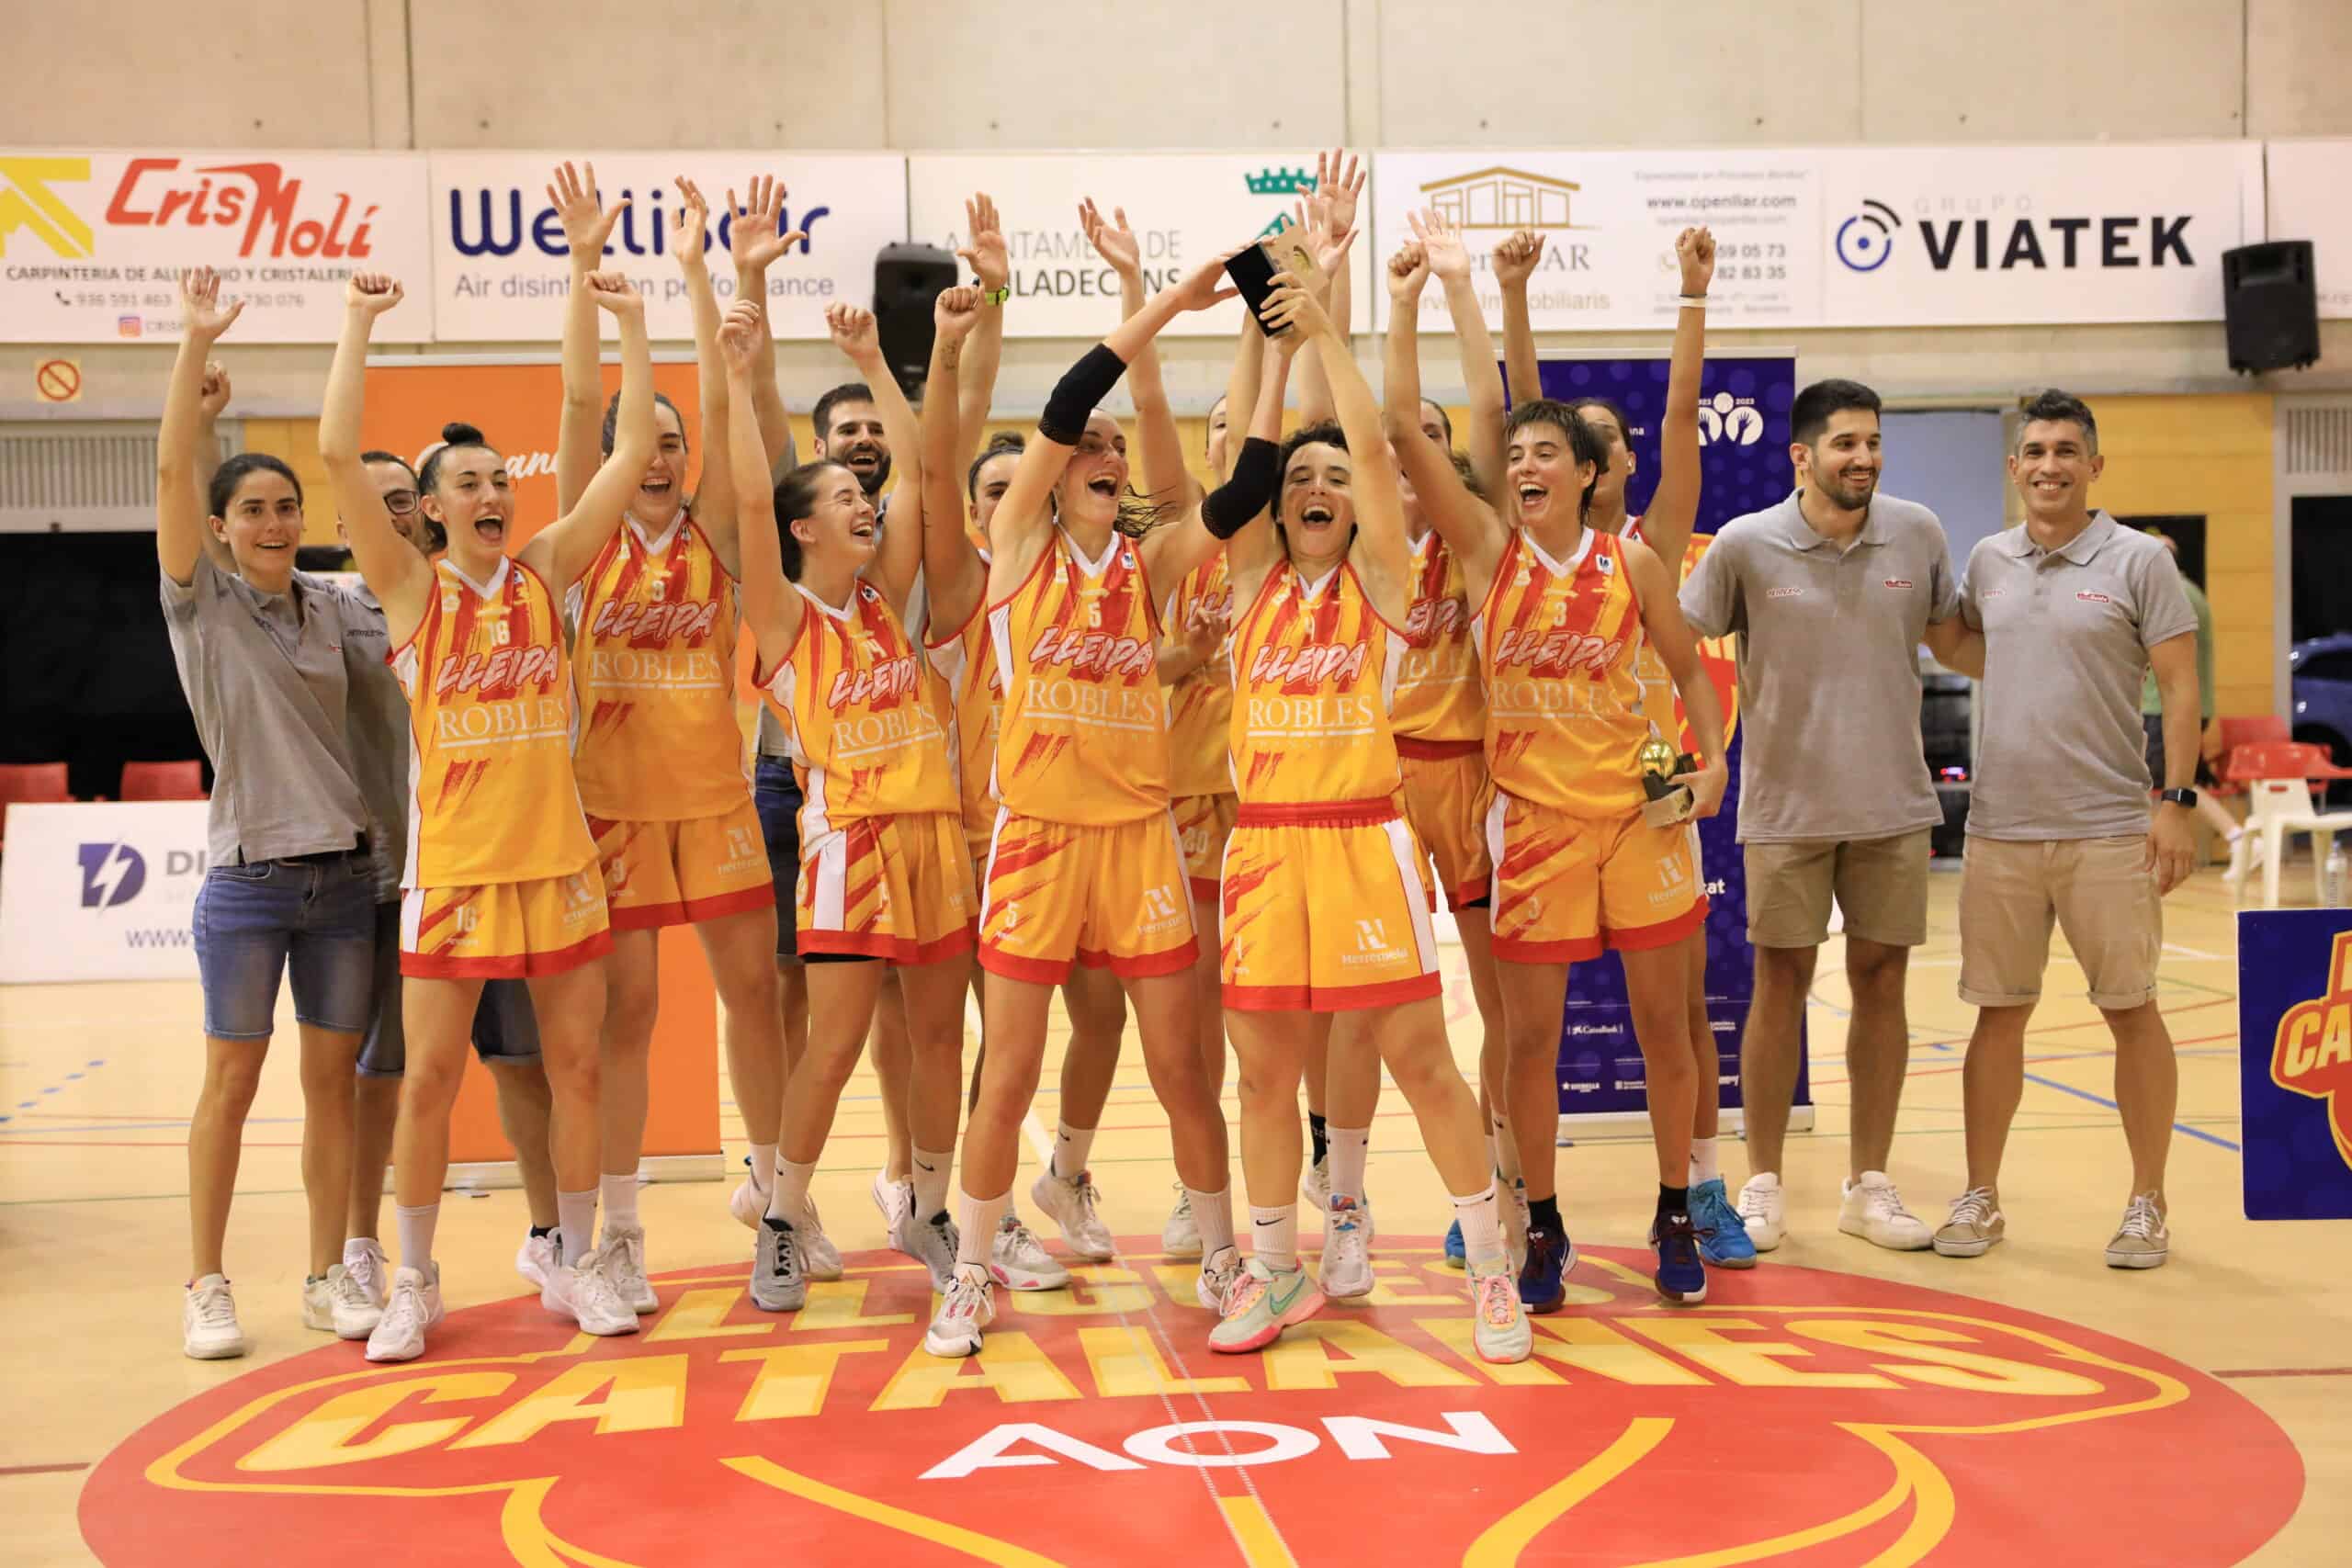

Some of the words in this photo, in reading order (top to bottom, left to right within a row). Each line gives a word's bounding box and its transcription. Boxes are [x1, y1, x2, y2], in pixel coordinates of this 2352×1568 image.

[1146, 231, 1182, 258] DE
[1917, 216, 2196, 270] VIATEK
[6, 265, 120, 283] CARPINTERIA
[124, 265, 147, 282] DE
[245, 266, 256, 282] Y
[260, 265, 354, 283] CRISTALERI
[454, 274, 492, 298] Air
[1006, 269, 1182, 298] ILADECNS
[1087, 603, 1103, 628] 5
[1552, 602, 1568, 626] 3
[1029, 625, 1156, 677] LLEIDA
[1249, 641, 1369, 684] LLEIDA
[435, 644, 560, 695] LLEIDA
[1026, 678, 1159, 722] ROBLES
[1248, 694, 1375, 729] ROBLES
[1006, 901, 1021, 929] 5
[234, 1316, 2106, 1472] CATALANES
[918, 1411, 1520, 1479] AON
